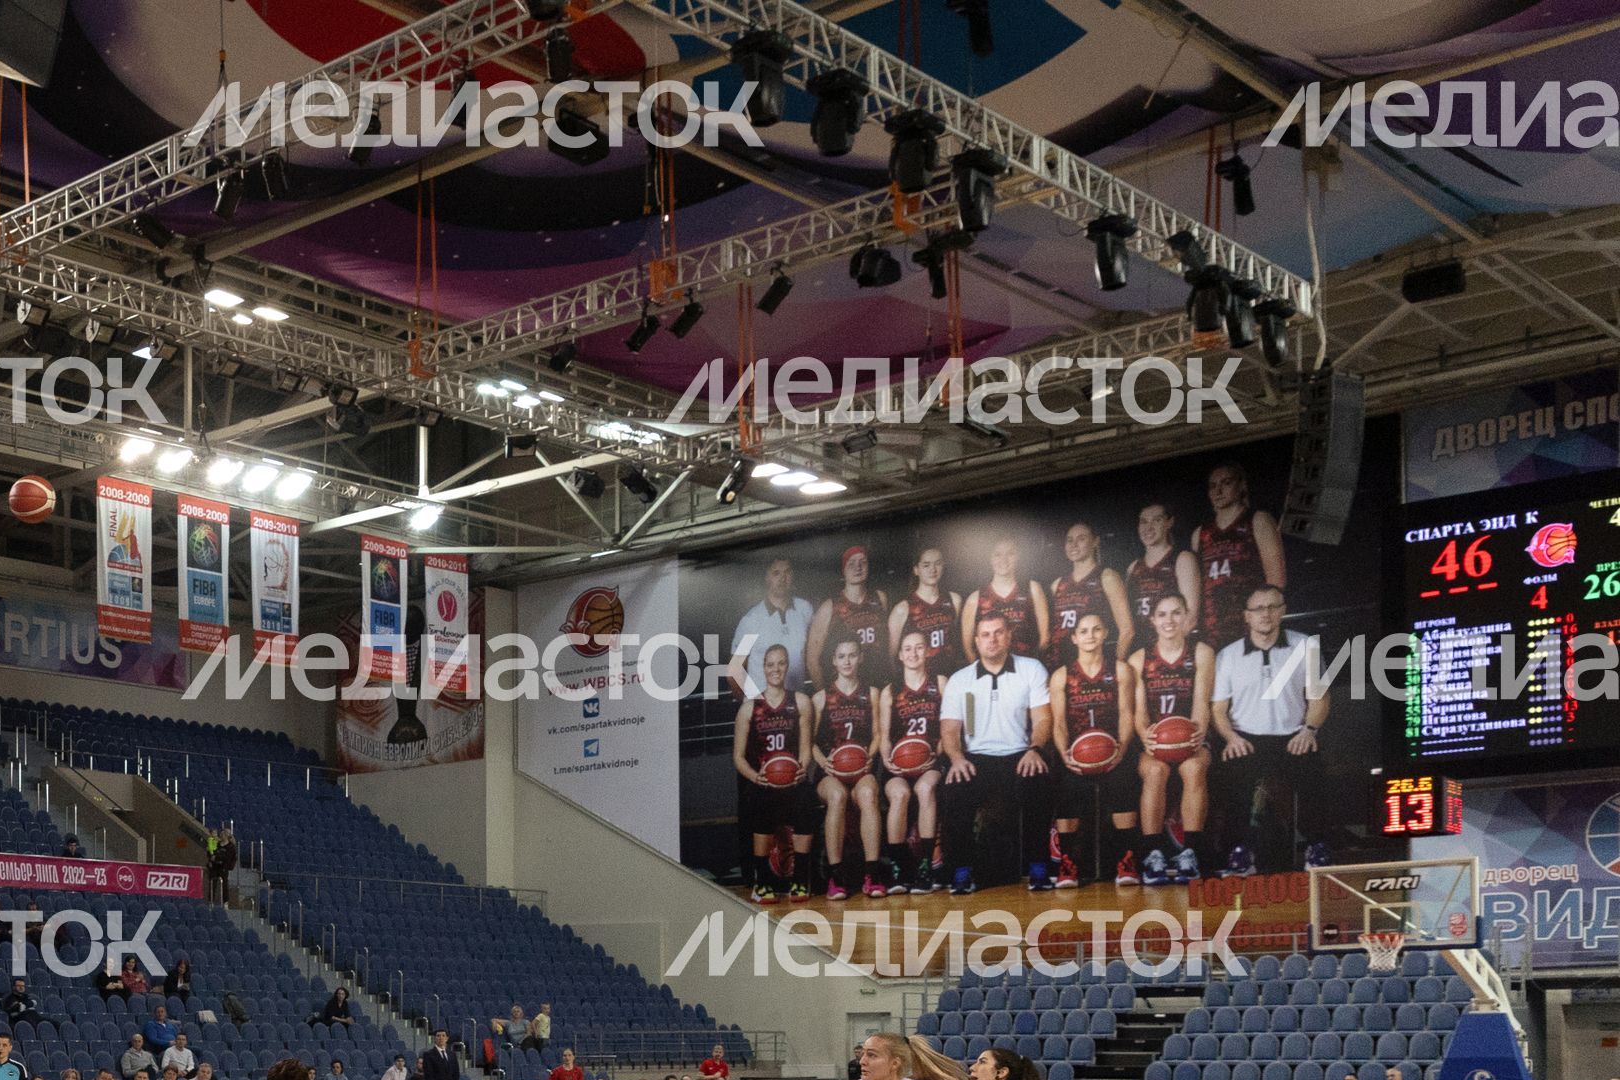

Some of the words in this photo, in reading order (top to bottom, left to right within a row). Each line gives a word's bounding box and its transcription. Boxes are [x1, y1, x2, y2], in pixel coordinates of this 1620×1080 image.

[1432, 406, 1556, 462] ДВОРЕЦ
[99, 485, 150, 505] 2008-2009
[181, 503, 228, 523] 2008-2009
[110, 508, 118, 538] FINAL
[253, 516, 298, 534] 2009-2010
[1405, 521, 1476, 543] СПАРТА
[1480, 514, 1517, 531] ЭНД
[1524, 510, 1539, 524] К
[364, 540, 406, 558] 2009-2010
[1431, 535, 1493, 581] 46
[428, 557, 467, 572] 2010-2011
[1209, 558, 1232, 580] 44
[193, 578, 217, 596] FIBA
[1523, 573, 1558, 585] ФОЛЫ
[1530, 585, 1548, 609] 4
[375, 610, 396, 626] FIBA
[1563, 624, 1577, 635] 16
[1160, 695, 1176, 714] 17
[547, 714, 645, 735] vk.com/spartakvidnoje
[907, 717, 927, 736] 23
[1088, 709, 1095, 727] 1
[844, 722, 853, 740] 7
[766, 733, 785, 751] 30
[553, 757, 639, 775] t.me/spartakvidnoje
[1387, 776, 1432, 793] 26.6
[1383, 794, 1433, 832] 13
[147, 873, 189, 889] PARI
[1364, 876, 1420, 891] PARI
[1484, 864, 1578, 885] дворец
